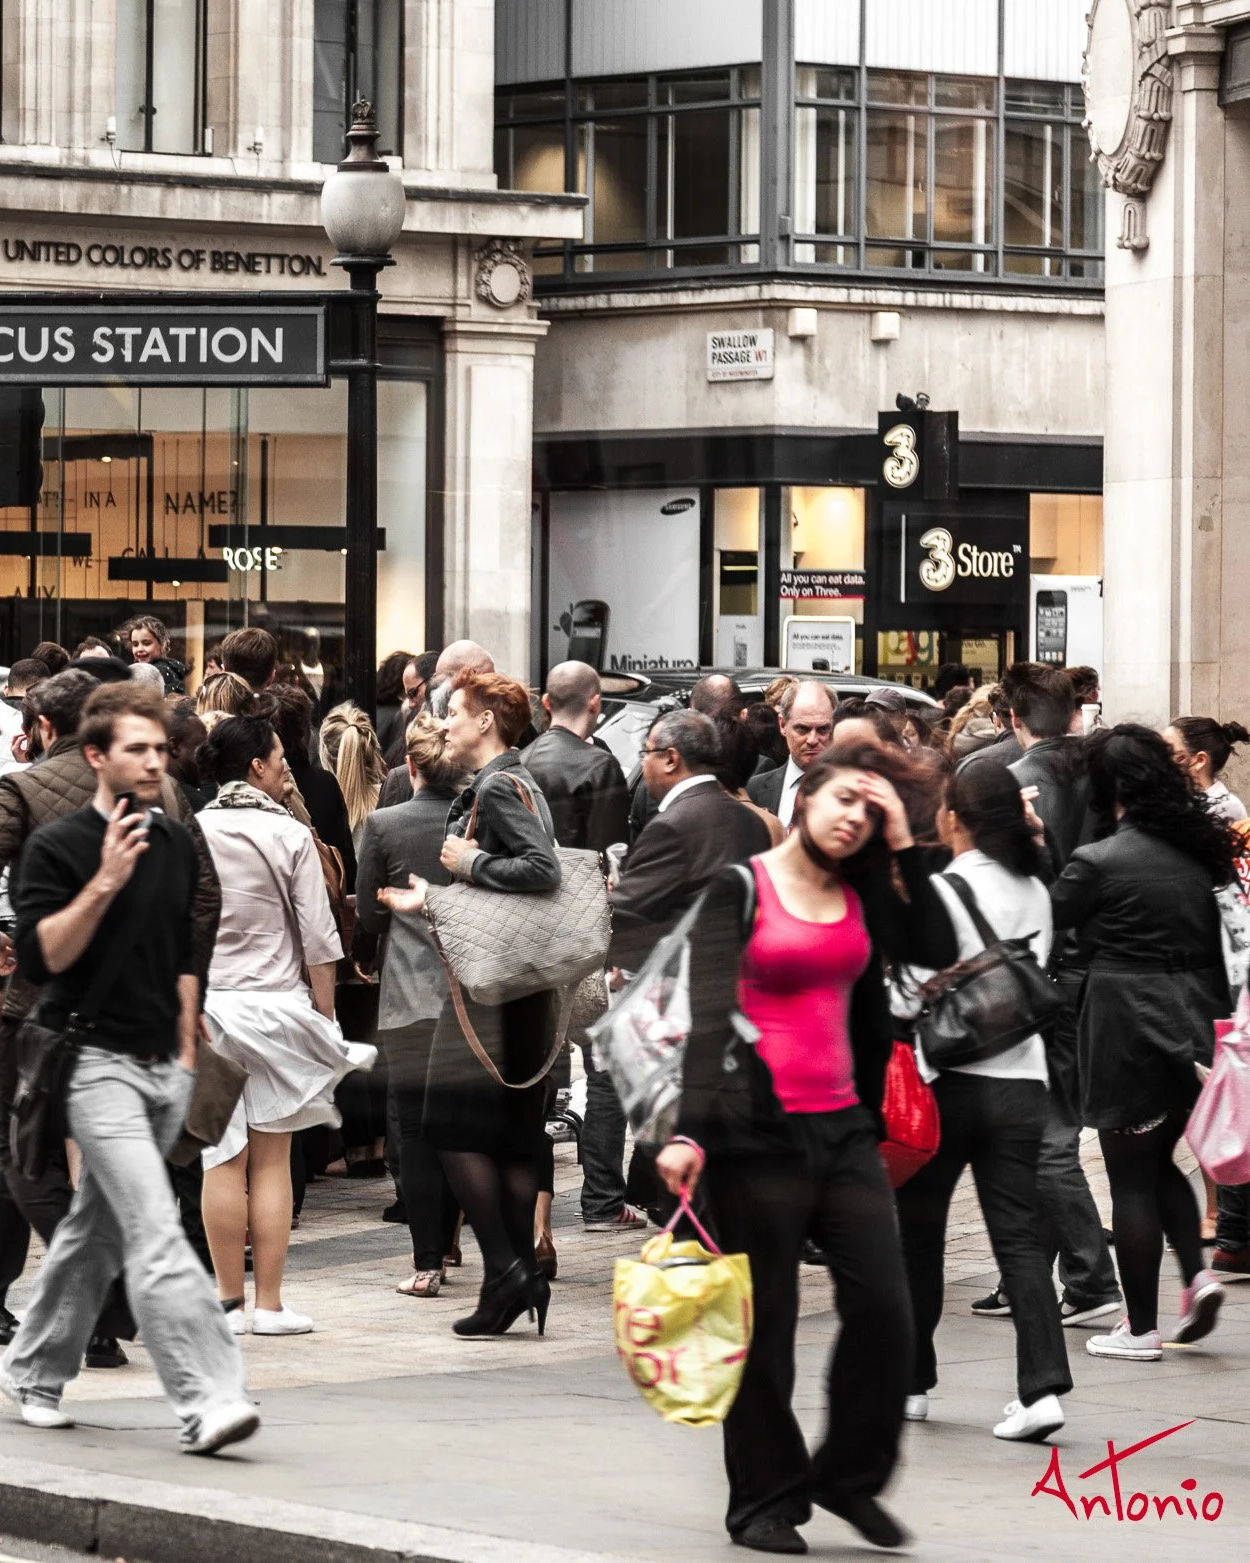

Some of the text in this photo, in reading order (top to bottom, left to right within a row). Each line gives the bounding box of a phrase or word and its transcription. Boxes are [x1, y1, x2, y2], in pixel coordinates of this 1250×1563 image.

[3, 239, 327, 276] UNITED COLORS OF BENETTON.
[91, 326, 284, 363] STATION
[711, 335, 758, 349] SWALLOW
[711, 350, 767, 364] PASSAGE W1
[883, 424, 920, 488] 3
[84, 491, 239, 515] IN A NAME?
[222, 547, 280, 571] ROSE
[919, 527, 956, 592] 3
[957, 543, 1015, 577] Store
[781, 573, 866, 585] All you can eat data.
[780, 585, 842, 598] Only on Three.
